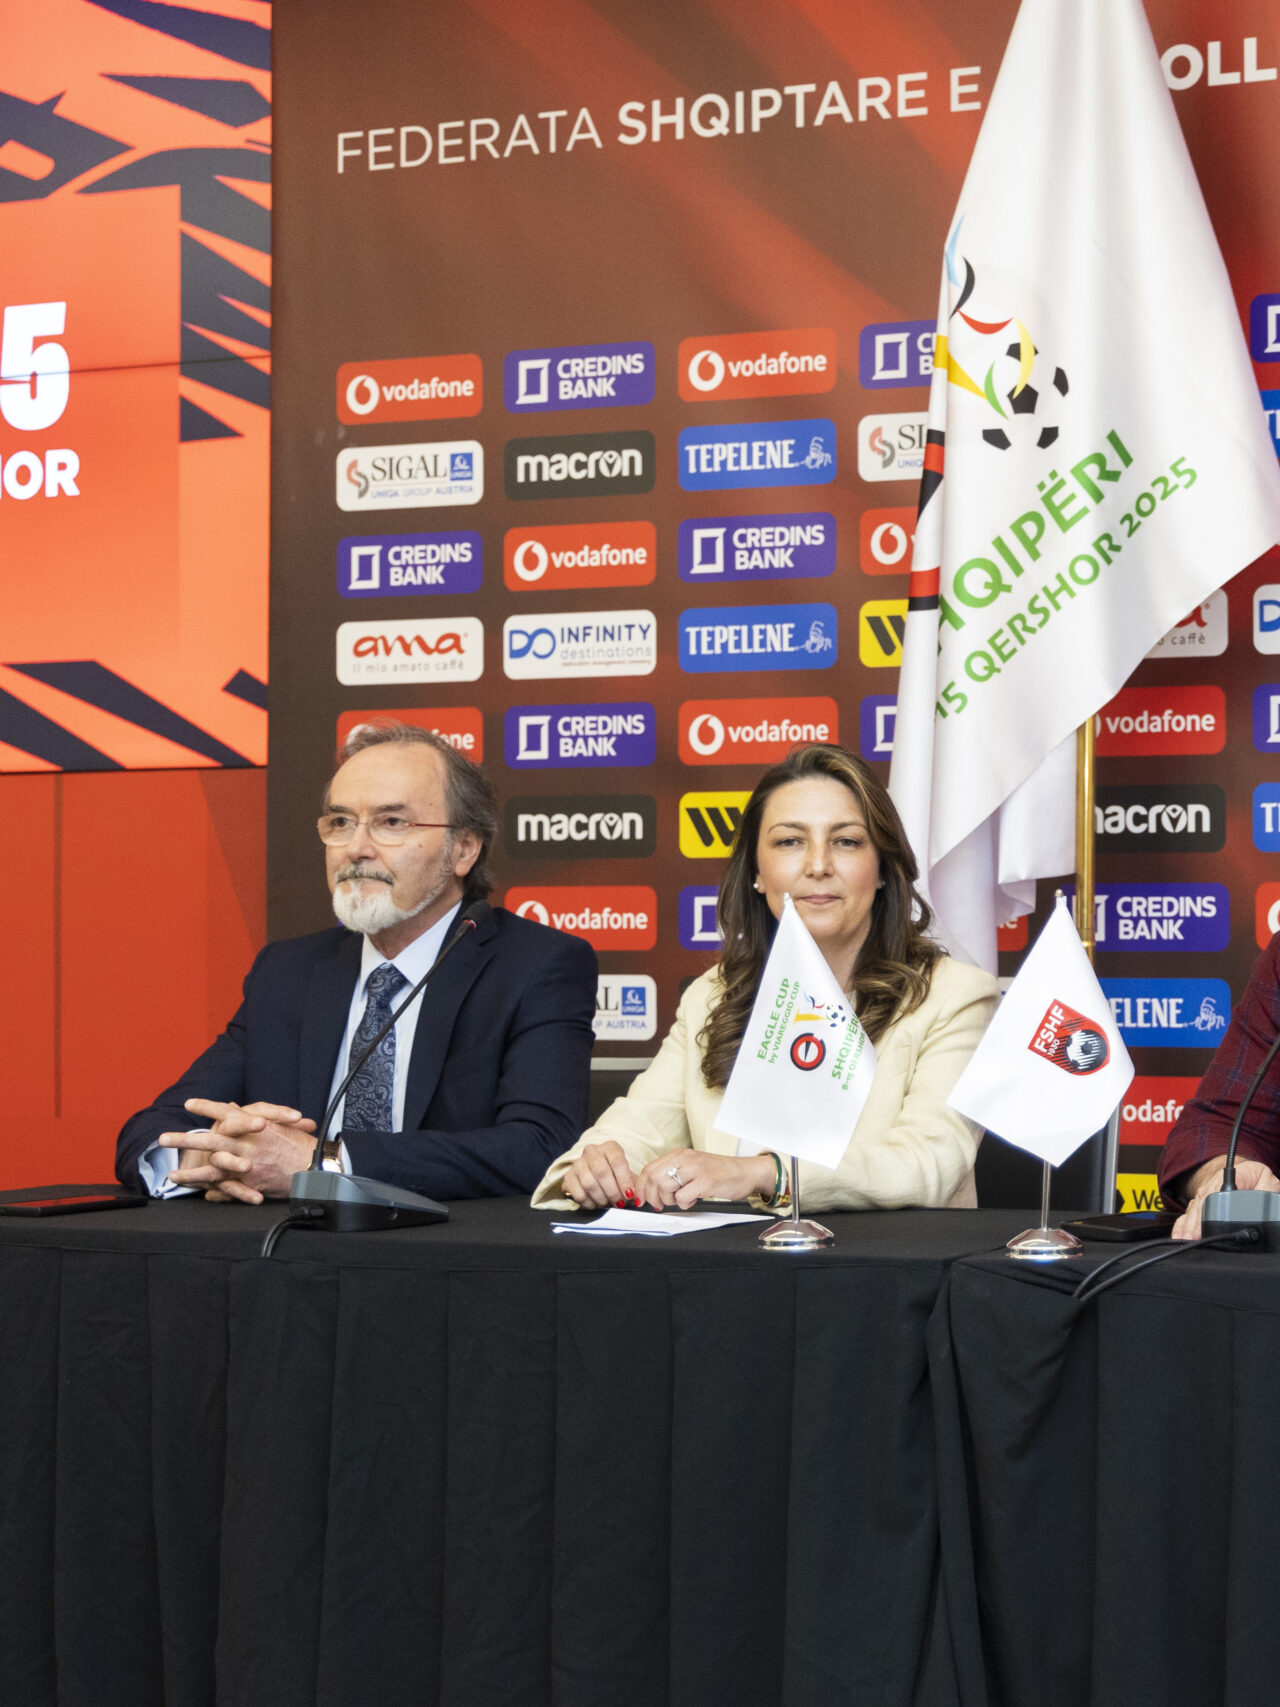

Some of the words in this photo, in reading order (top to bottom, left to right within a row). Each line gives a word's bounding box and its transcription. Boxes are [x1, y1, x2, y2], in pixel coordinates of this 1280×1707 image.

[338, 107, 602, 174] FEDERATA
[617, 71, 928, 146] SHQIPTARE
[950, 66, 982, 113] E
[557, 354, 645, 379] CREDINS
[728, 351, 827, 377] vodafone
[382, 377, 474, 402] vodafone
[559, 377, 616, 400] BANK
[371, 454, 448, 482] SIGAL
[517, 449, 642, 483] macron
[685, 439, 796, 474] TEPELENE
[0, 449, 80, 500] OR
[732, 525, 825, 548] CREDINS
[388, 543, 472, 566] CREDINS
[551, 544, 647, 569] vodafone
[735, 547, 794, 570] BANK
[389, 565, 445, 587] BANK
[964, 532, 1122, 683] QERSHOR
[1119, 456, 1197, 538] 2025
[353, 632, 465, 658] ama
[560, 623, 651, 644] INFINITY
[685, 623, 795, 655] TEPELENE
[1171, 633, 1205, 646] caffè
[560, 645, 652, 660] destinations
[365, 661, 387, 674] mio
[392, 661, 429, 674] amato
[436, 658, 464, 672] caffè
[557, 714, 645, 736] CREDINS
[728, 719, 829, 744] vodafone
[1105, 710, 1215, 734] vodafone
[559, 735, 616, 758] BANK
[517, 812, 643, 842] macron
[552, 907, 648, 931] vodafone
[1116, 895, 1217, 920] CREDINS
[1118, 918, 1184, 941] BANK
[622, 1004, 646, 1014] UNIQA
[757, 1010, 781, 1059] EAGLE
[776, 977, 790, 1008] CUP
[773, 1001, 794, 1051] VIAREGGIO
[790, 981, 800, 1000] CUP
[606, 1020, 647, 1030] AUSTRIA
[1033, 1004, 1065, 1053] FSHF
